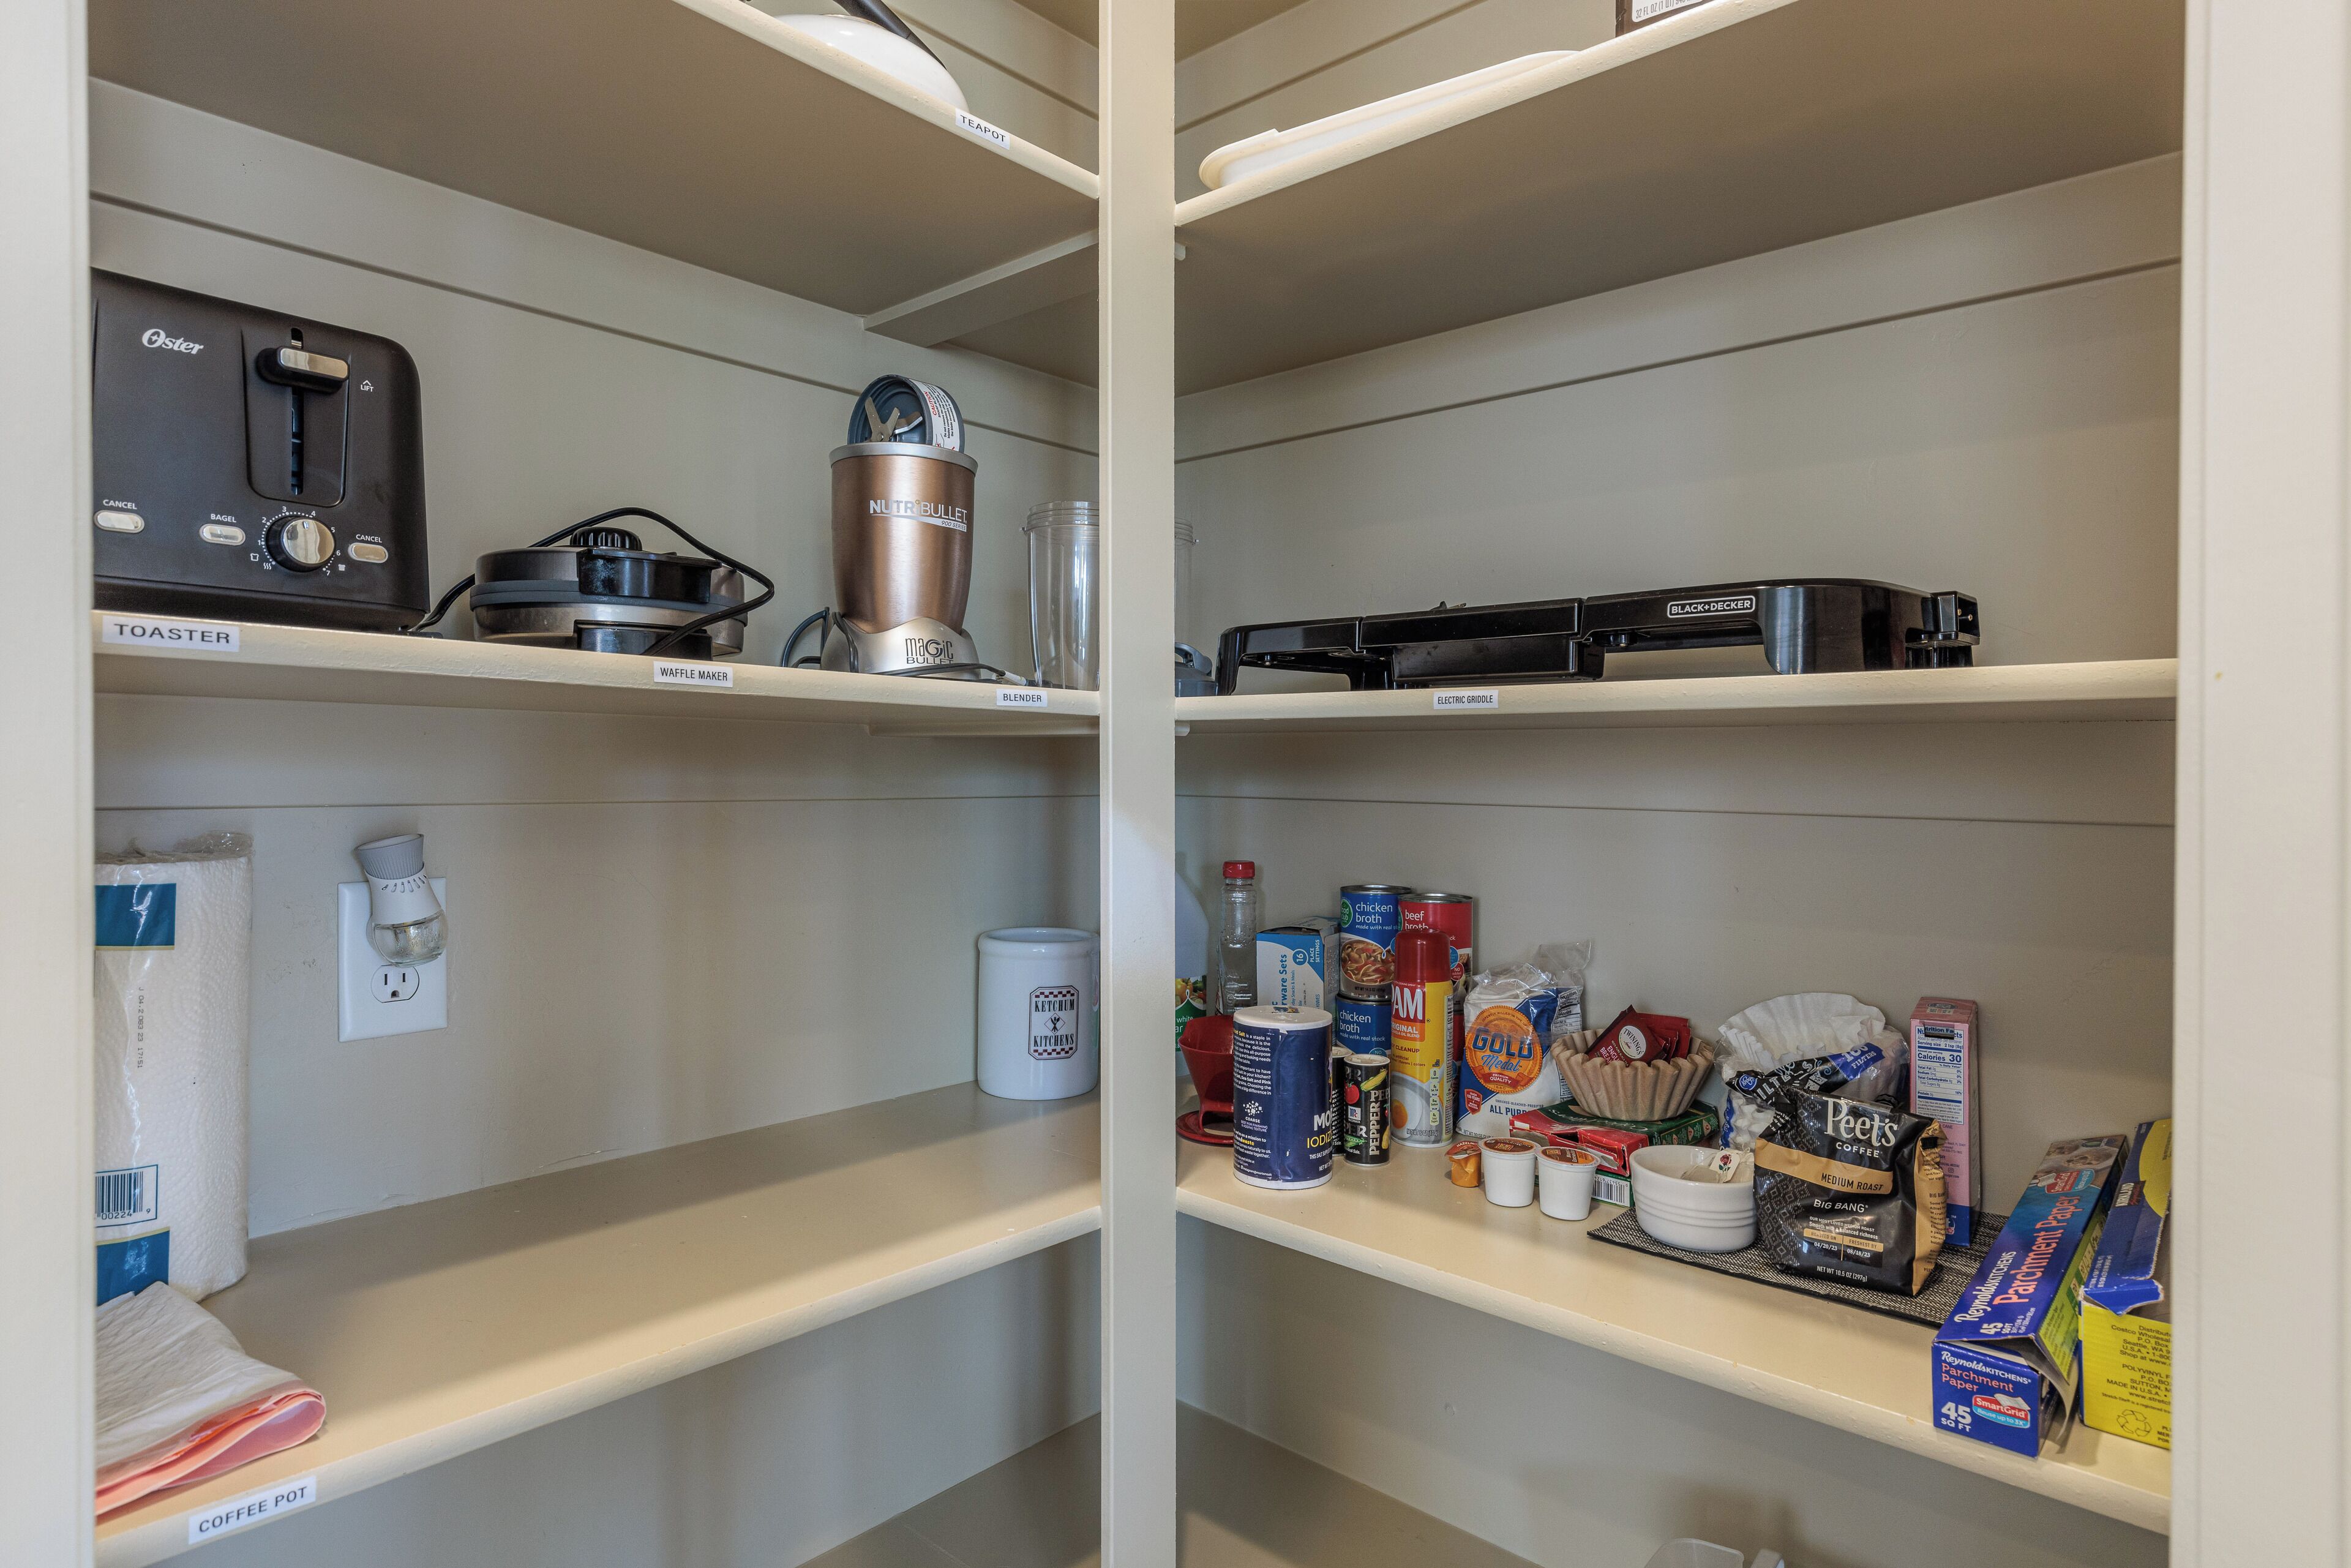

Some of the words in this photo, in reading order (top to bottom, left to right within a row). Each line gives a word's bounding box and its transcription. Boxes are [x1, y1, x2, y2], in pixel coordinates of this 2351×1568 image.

[1636, 9, 1642, 19] 32
[1643, 6, 1649, 16] FL
[1651, 2, 1657, 13] OZ
[960, 114, 1006, 142] TEAPOT
[142, 328, 204, 354] Oster
[360, 383, 374, 392] LIFT
[103, 499, 138, 510] CANCEL
[211, 513, 237, 523] BAGEL
[356, 534, 383, 543] CANCEL
[1671, 600, 1751, 614] BLACK+DECKER
[114, 623, 230, 644] TOASTER
[660, 667, 696, 679] WAFFLE
[699, 670, 727, 681] MAKER
[1003, 693, 1042, 702] BLENDER
[1438, 696, 1465, 704] ELECTRIC
[1467, 695, 1493, 703] GRIDDLE
[1355, 902, 1392, 912] chicken
[1355, 912, 1381, 923] broth
[1404, 910, 1424, 921] beef
[1297, 953, 1304, 962] 16
[1279, 954, 1288, 975] Sets
[1035, 999, 1074, 1012] KETCHUM
[1340, 1010, 1371, 1024] chicken
[1340, 1021, 1360, 1033] broth
[1391, 1022, 1418, 1033] RIGINAL
[137, 1032, 143, 1042] 23
[1033, 1033, 1074, 1047] KITCHENS
[1472, 1026, 1533, 1060] GOLD
[1396, 1045, 1420, 1053] CLEANUP
[1481, 1054, 1522, 1073] Medal
[1851, 1051, 1876, 1069] FILTERS
[1918, 1052, 1946, 1062] Calories
[1949, 1054, 1962, 1063] 30
[1490, 1105, 1503, 1114] ALL
[1369, 1101, 1380, 1155] PEPPER
[1823, 1097, 1898, 1147] Peet's
[1307, 1130, 1332, 1149] IODIZ
[1836, 1142, 1880, 1157] COFFEE
[1821, 1172, 1854, 1190] MEDIUM
[1856, 1182, 1883, 1191] ROAST
[2116, 1183, 2134, 1207] KIRKLAND
[1813, 1199, 1832, 1209] BIG
[102, 1210, 132, 1220] 00224
[1811, 1231, 1829, 1240] ROASTED
[1839, 1227, 1859, 1236] balanced
[1859, 1231, 1878, 1240] richness
[1814, 1242, 1837, 1251] 04/20/23
[1849, 1239, 1870, 1248] FRESHEST
[1993, 1229, 2064, 1305] Parchment
[2035, 1195, 2083, 1229] Paper
[1847, 1248, 1870, 1258] 08/18/23
[1853, 1274, 1867, 1283] (297g)
[1980, 1322, 2003, 1335] 45
[2112, 1325, 2135, 1335] Costco
[2139, 1331, 2171, 1342] Wholesal
[2123, 1339, 2149, 1349] Seattle,
[2123, 1345, 2144, 1354] U.S.A.
[2120, 1350, 2138, 1359] Shop
[1942, 1363, 2014, 1392] Parchment
[2122, 1364, 2164, 1378] POLYVINYL
[1942, 1373, 1979, 1392] Paper
[2107, 1379, 2128, 1389] MADE
[2140, 1387, 2161, 1397] U.S.A.
[2131, 1379, 2162, 1392] SUTTON,
[1941, 1401, 1972, 1424] 45
[1976, 1397, 2026, 1418] SmartGrid
[1978, 1408, 1996, 1419] Reuse
[1941, 1417, 1955, 1428] SQ
[1959, 1423, 1971, 1433] FT
[200, 1499, 268, 1533] COFFEE
